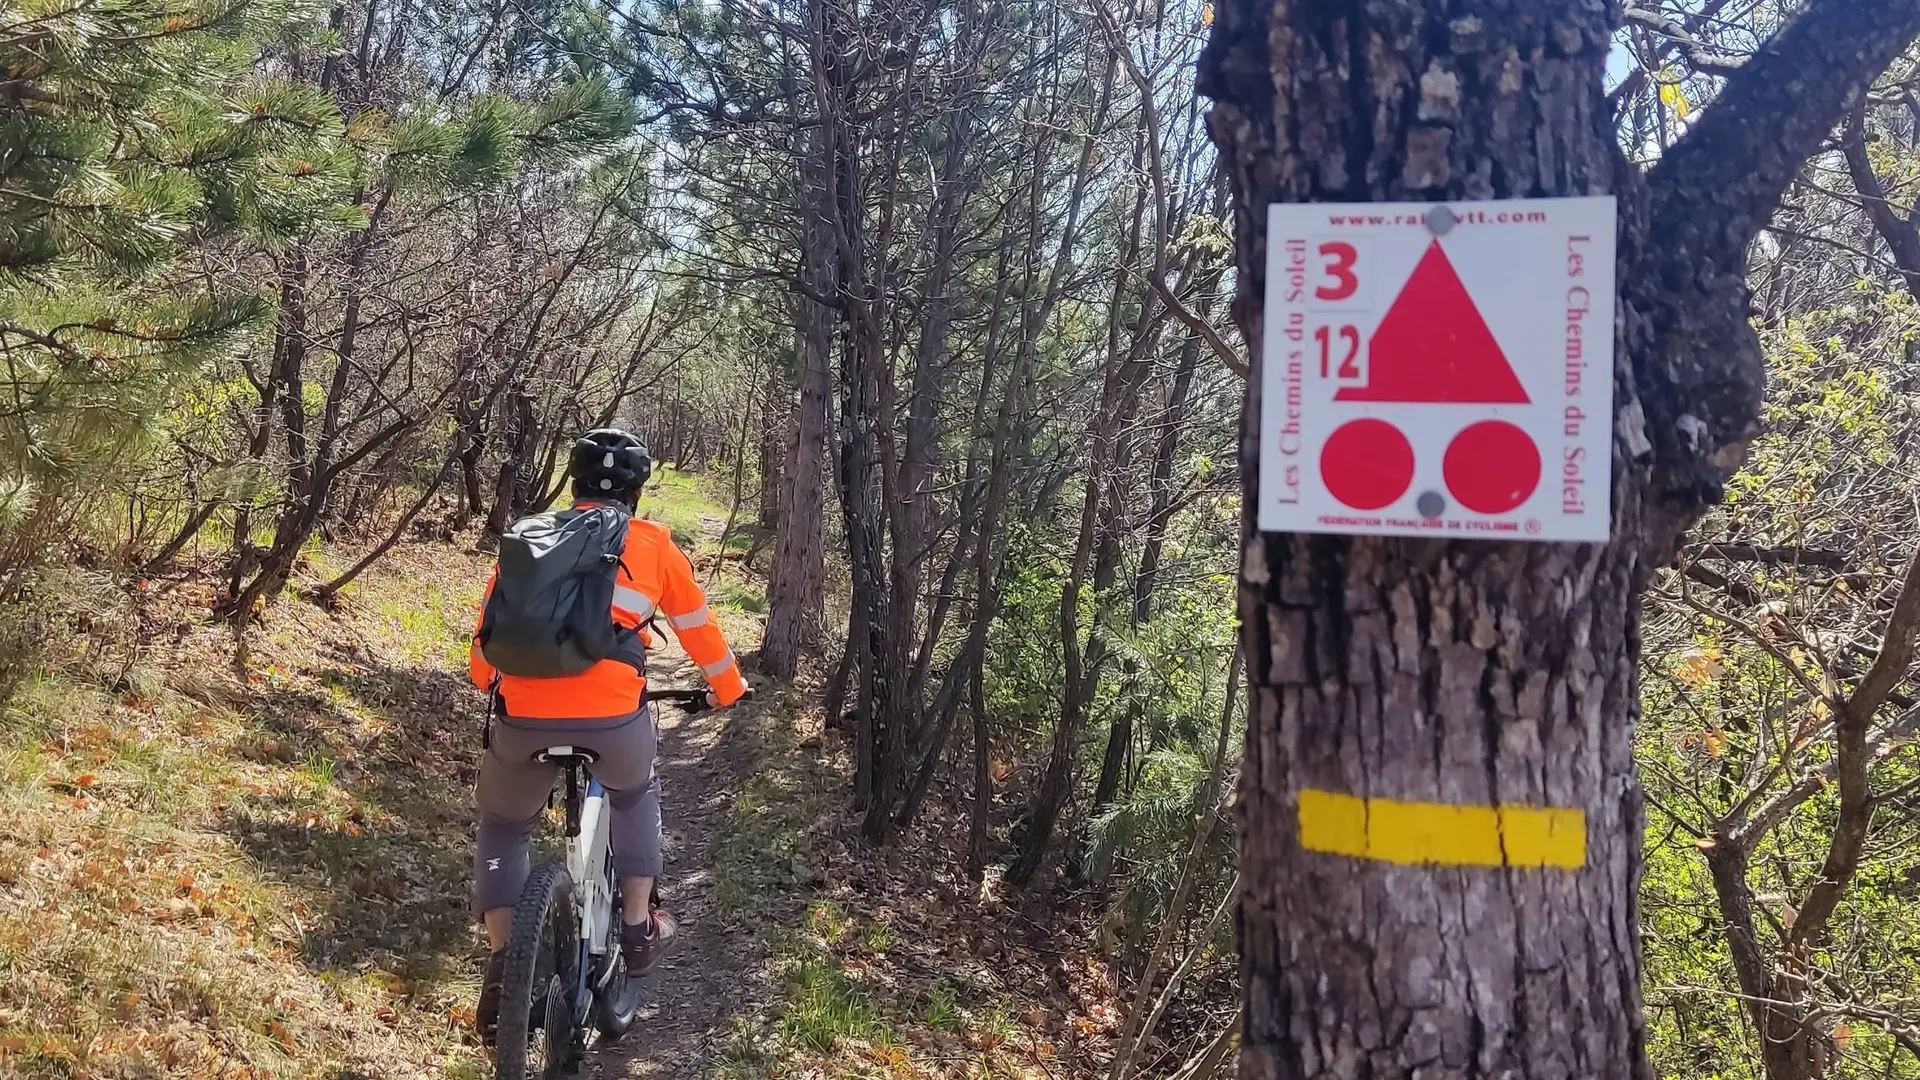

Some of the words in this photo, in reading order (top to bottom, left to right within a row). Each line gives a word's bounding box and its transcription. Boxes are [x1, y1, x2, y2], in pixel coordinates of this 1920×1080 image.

[1285, 239, 1306, 302] Soleil
[1315, 241, 1358, 301] 3
[1567, 235, 1590, 276] Les
[1283, 312, 1304, 342] du
[1314, 324, 1359, 379] 12
[1565, 286, 1590, 396] Chemins
[1279, 351, 1302, 455] Chemins
[1564, 405, 1586, 436] du
[1278, 465, 1299, 504] Les
[1562, 446, 1586, 515] Soleil
